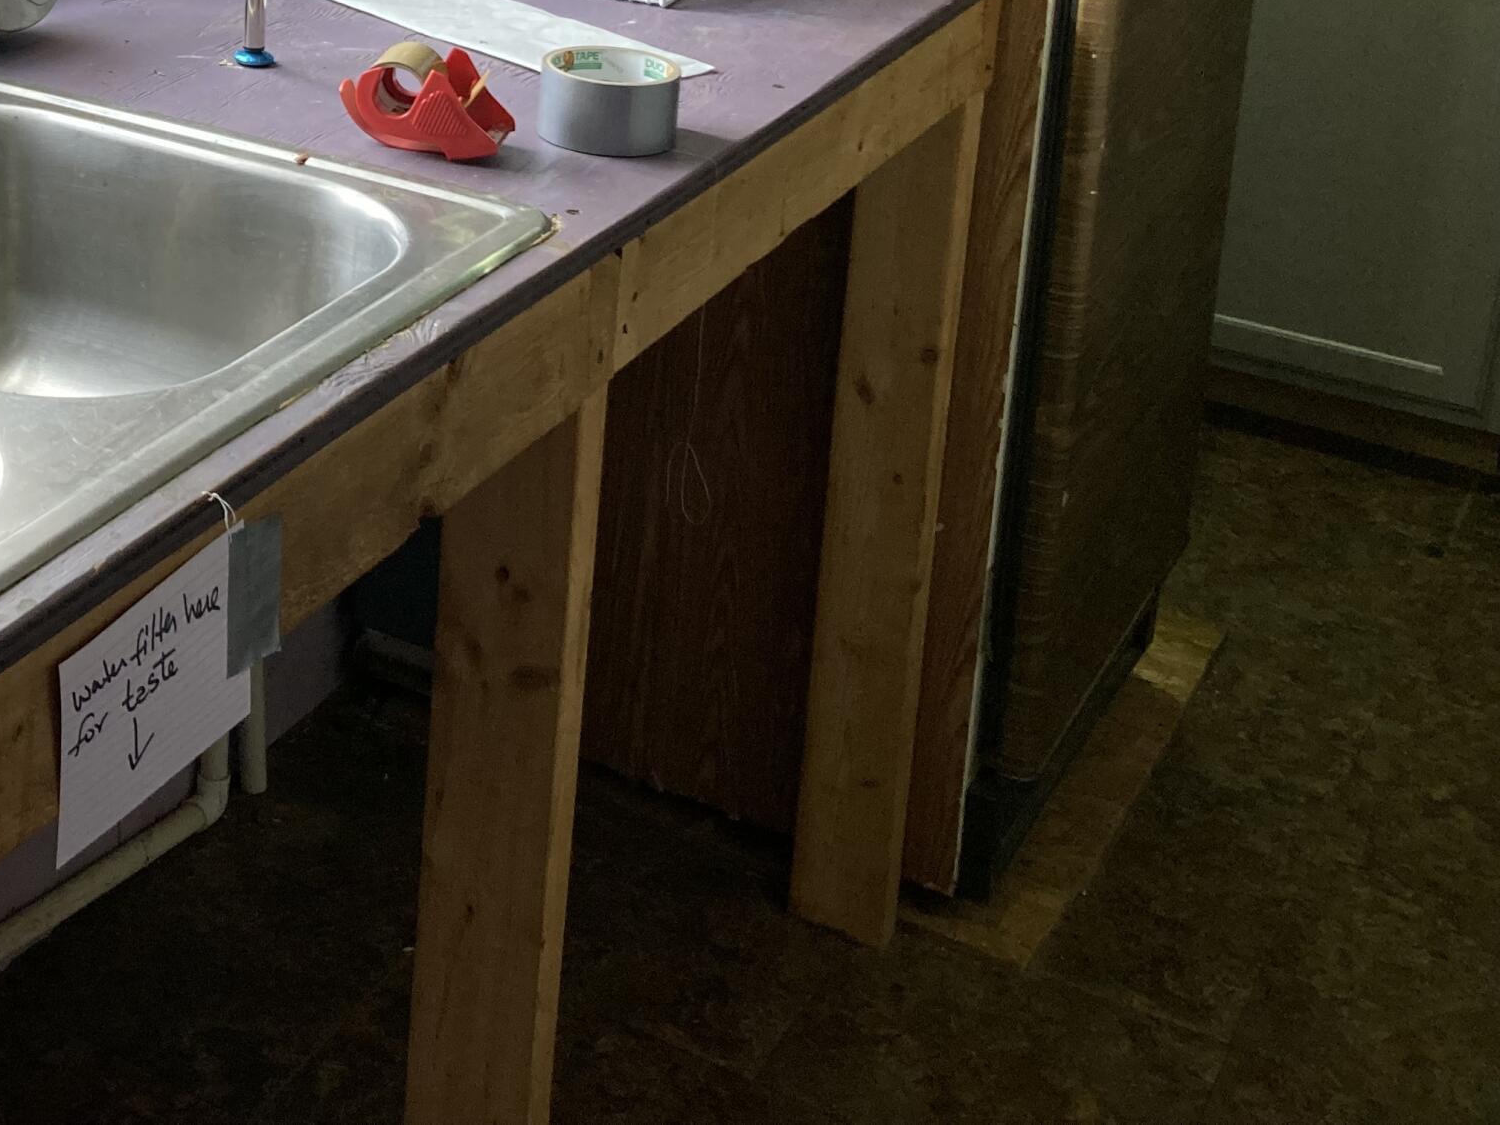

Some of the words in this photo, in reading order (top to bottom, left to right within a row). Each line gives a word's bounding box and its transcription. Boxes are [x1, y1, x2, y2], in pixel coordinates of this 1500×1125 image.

[575, 51, 600, 61] TAPE
[183, 586, 221, 624] here
[68, 712, 108, 757] for
[122, 648, 179, 711] taste
